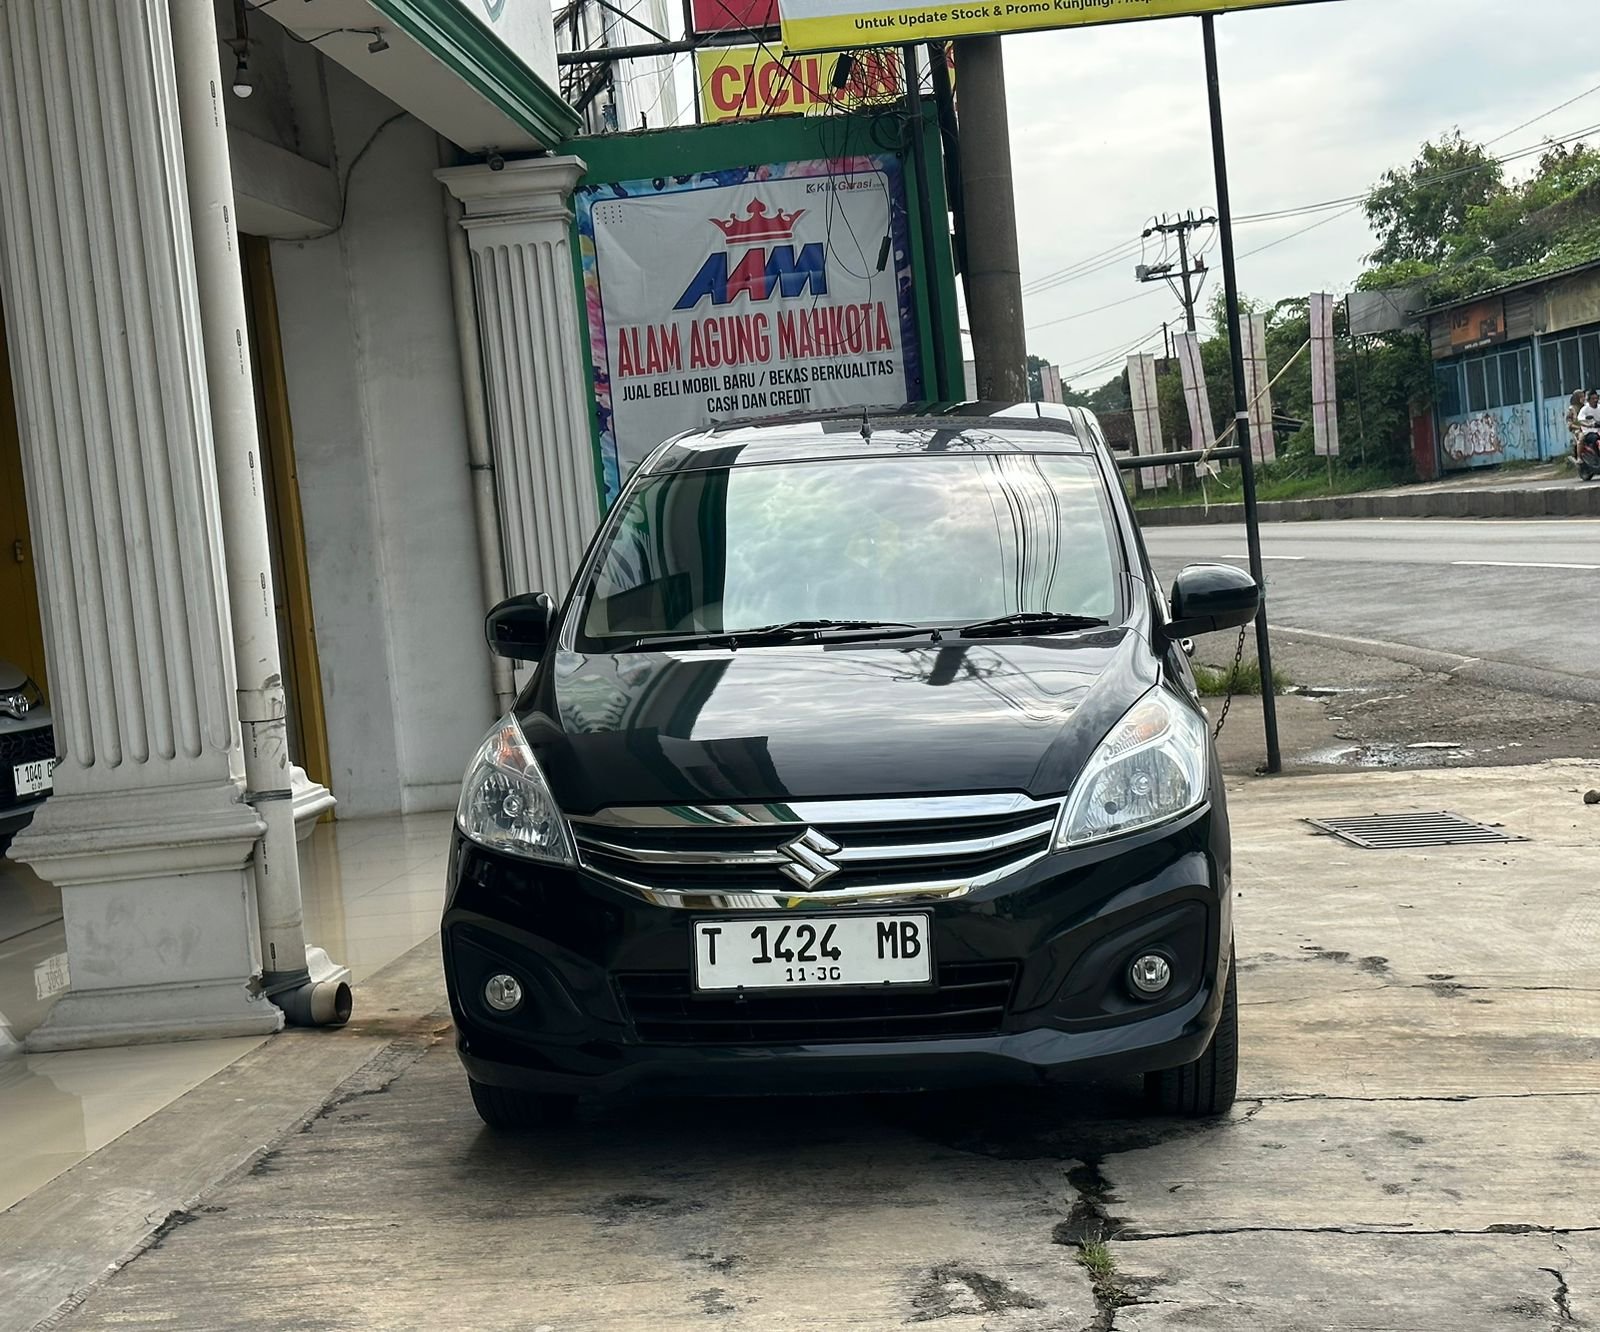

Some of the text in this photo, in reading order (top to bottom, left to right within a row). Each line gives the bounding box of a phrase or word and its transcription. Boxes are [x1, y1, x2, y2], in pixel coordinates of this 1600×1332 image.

[855, 15, 896, 29] Untuk
[899, 12, 948, 26] Update
[951, 7, 989, 20] Stock
[993, 5, 1002, 16] &
[1006, 3, 1050, 14] Promo
[711, 52, 897, 111] CICILAN
[672, 242, 828, 311] AAM
[618, 301, 892, 378] ALAM AGUNG MAHKOTA
[622, 360, 894, 402] JUAL BELI MOBIL BARU / BEKAS BERKUALITAS
[707, 388, 811, 413] CASH DAN CREDIT
[15, 768, 20, 785] T
[25, 763, 42, 783] 1040
[702, 921, 922, 966] T 1424 MB
